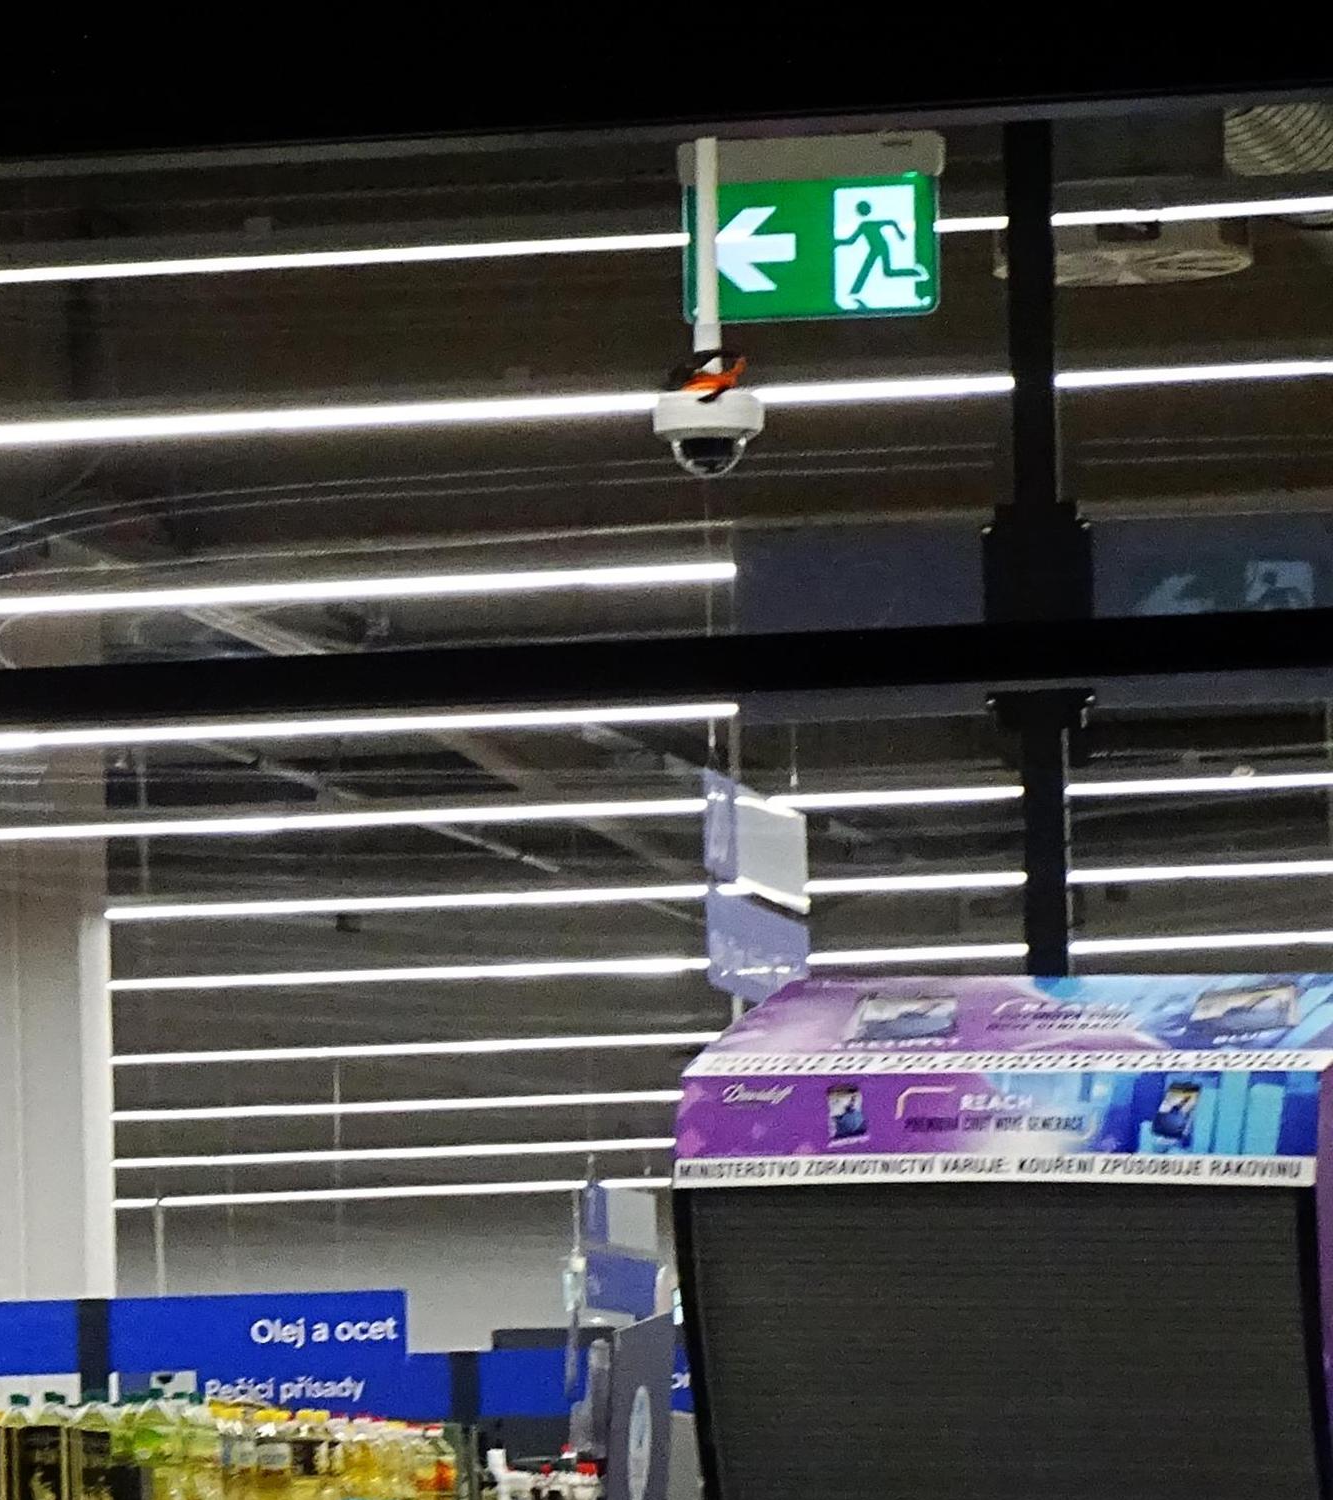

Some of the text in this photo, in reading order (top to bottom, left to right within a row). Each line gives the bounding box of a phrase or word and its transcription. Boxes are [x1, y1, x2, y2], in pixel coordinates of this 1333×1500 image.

[250, 1316, 399, 1349] Olej a ocet
[279, 1375, 365, 1403] přísady
